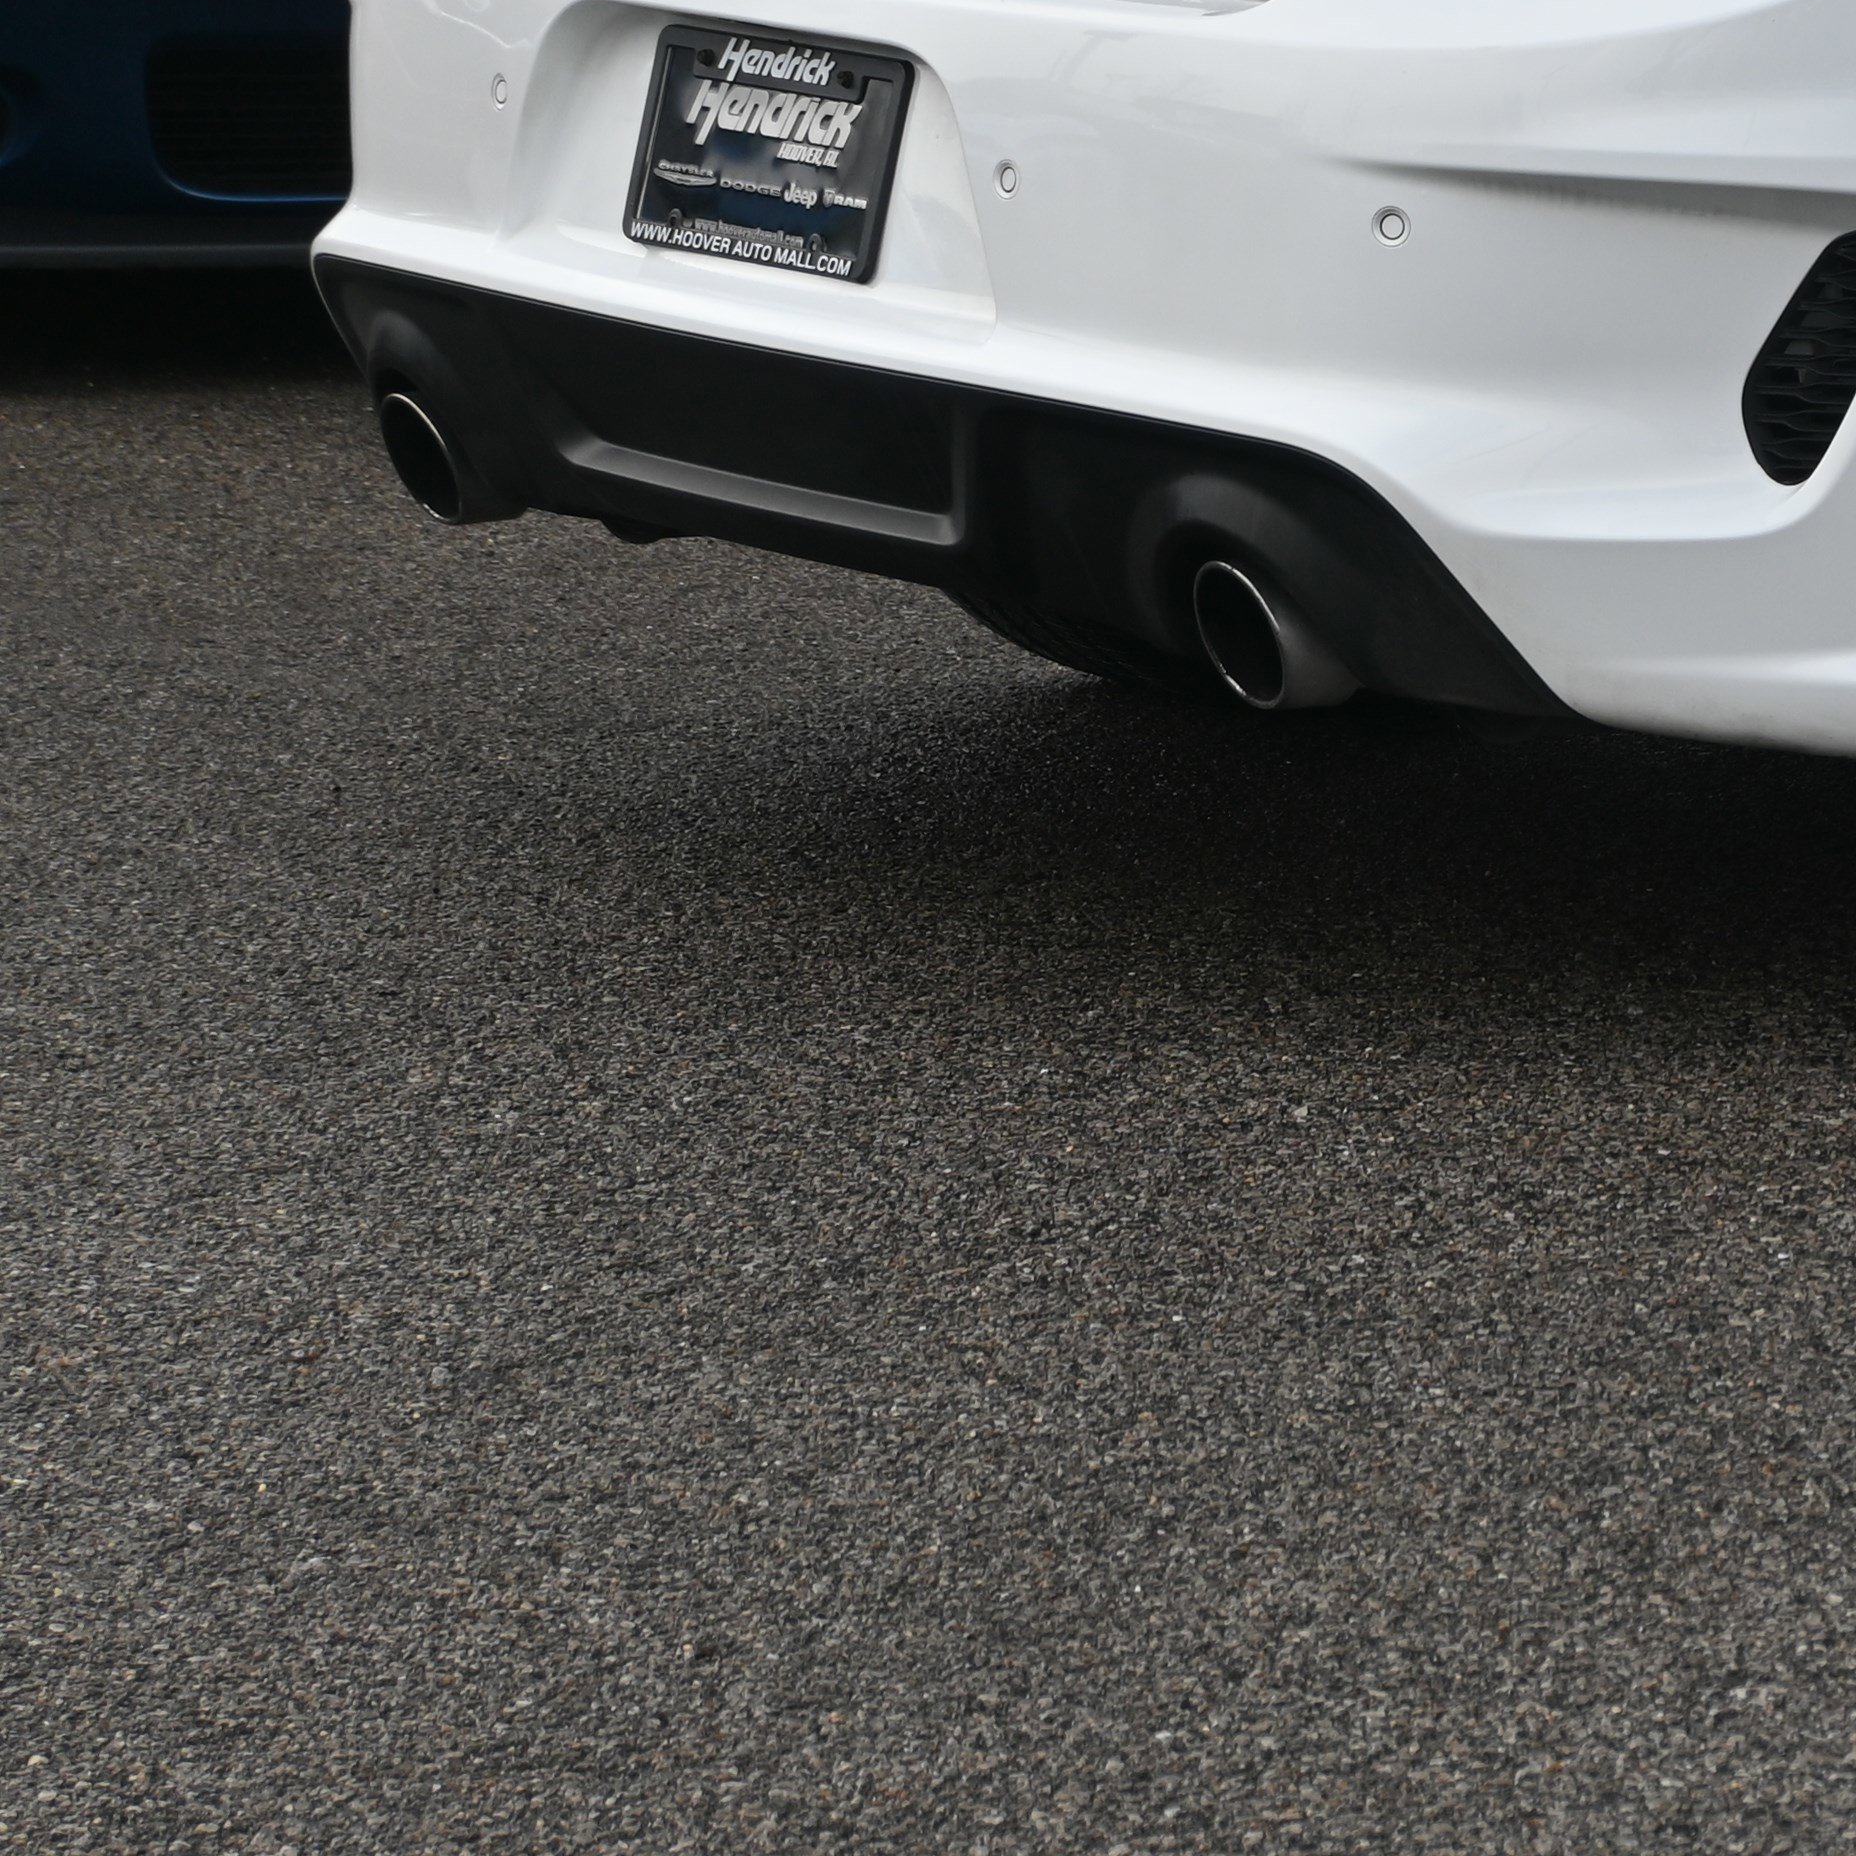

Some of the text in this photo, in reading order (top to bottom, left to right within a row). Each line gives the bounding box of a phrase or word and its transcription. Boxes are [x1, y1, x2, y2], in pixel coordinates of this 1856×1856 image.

[717, 37, 836, 86] Hendrick
[685, 78, 863, 148] Hendrick
[657, 159, 714, 178] CHRYSLER
[720, 177, 782, 197] DODGE
[783, 181, 818, 210] Jeep
[834, 195, 868, 210] RAM
[694, 218, 804, 248] www.hooverautomall.com
[630, 221, 852, 277] WWW.HOOVER AUTO MALL.COM
